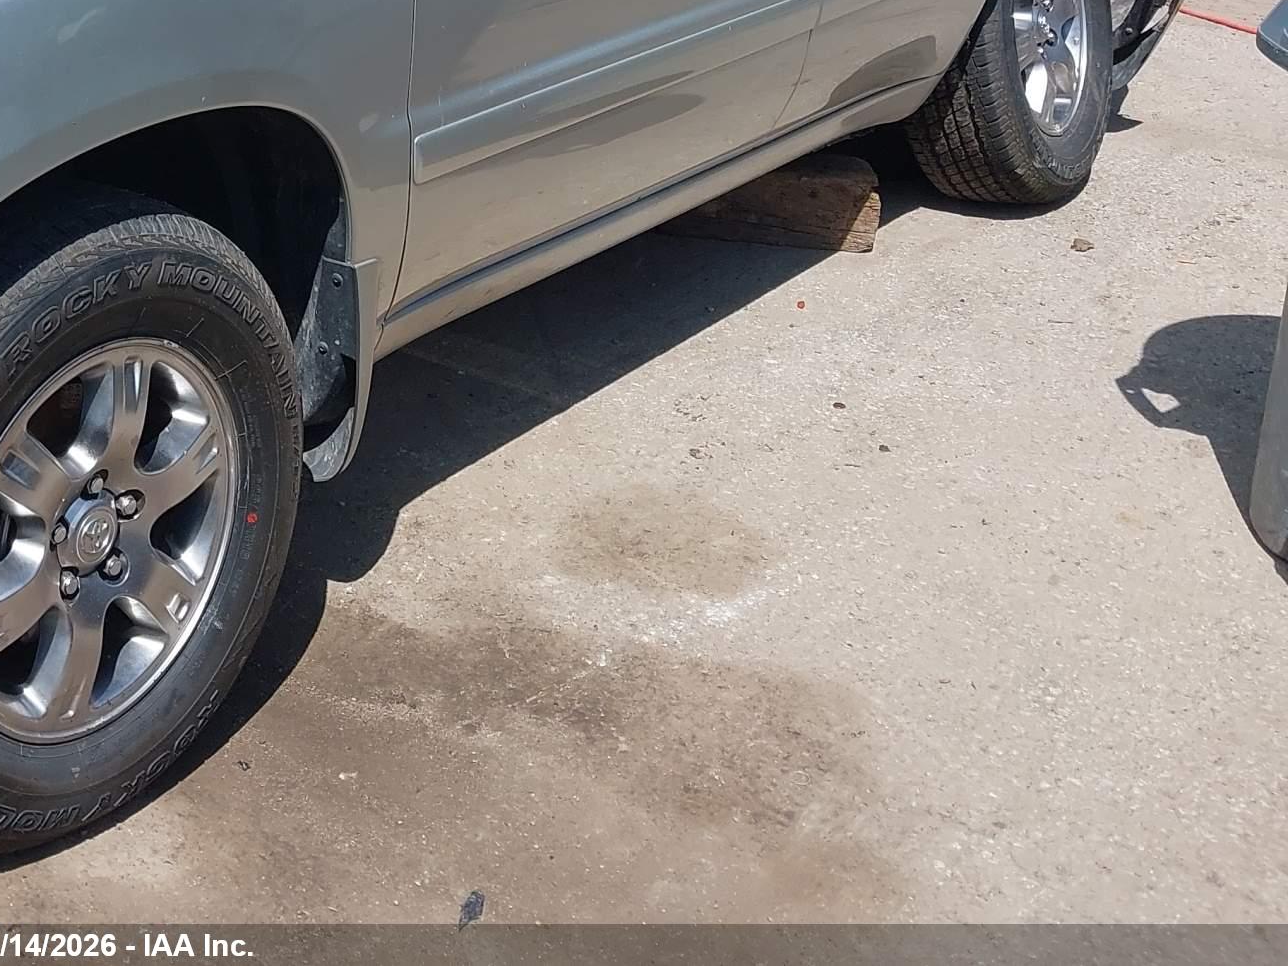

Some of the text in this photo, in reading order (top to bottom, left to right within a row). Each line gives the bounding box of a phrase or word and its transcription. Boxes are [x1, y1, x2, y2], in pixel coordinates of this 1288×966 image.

[0, 262, 299, 420] ROCKY MOUNTAIN
[82, 688, 220, 822] ROCKY
